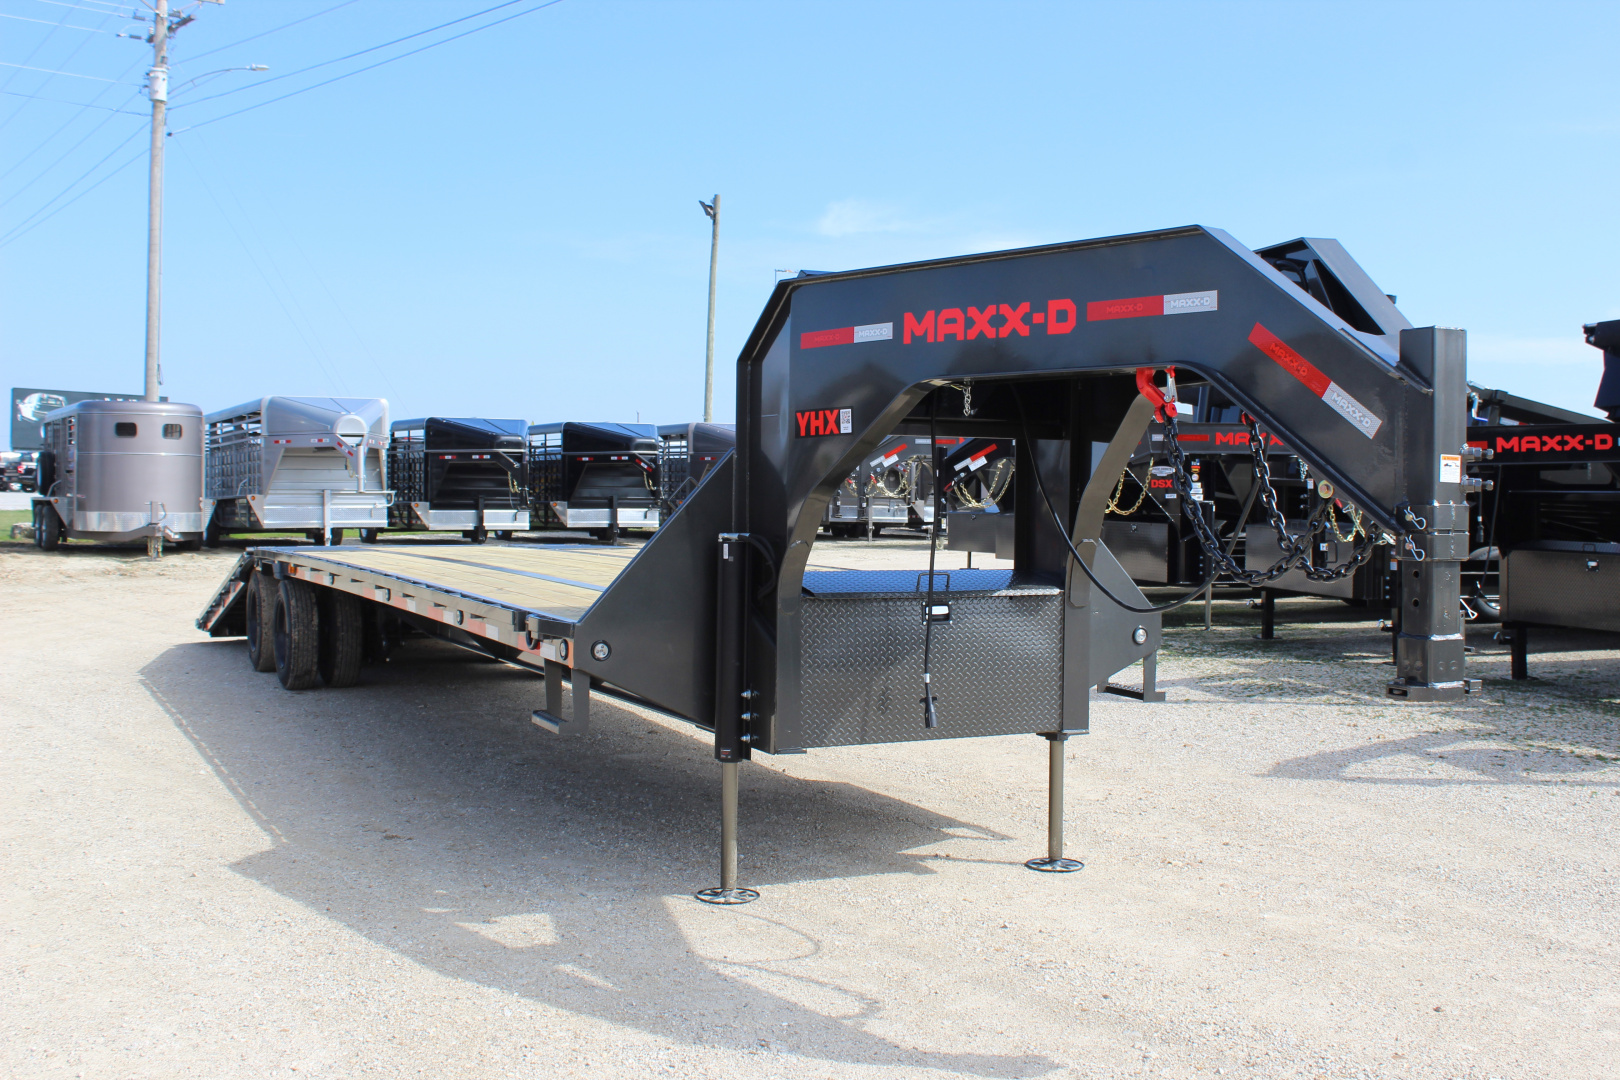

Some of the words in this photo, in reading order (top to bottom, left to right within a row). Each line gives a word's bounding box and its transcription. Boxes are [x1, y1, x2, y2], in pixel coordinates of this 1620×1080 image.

[1106, 303, 1144, 314] MAXX-D
[1170, 296, 1210, 309] MAXX-D
[903, 298, 1077, 344] MAXX-D
[858, 328, 888, 338] MAXX-D
[1269, 342, 1308, 376] MAXX-D
[1331, 392, 1372, 428] MAXX-D
[796, 409, 840, 437] YHX
[1496, 434, 1613, 453] MAXX-D
[1151, 479, 1173, 489] DSX
